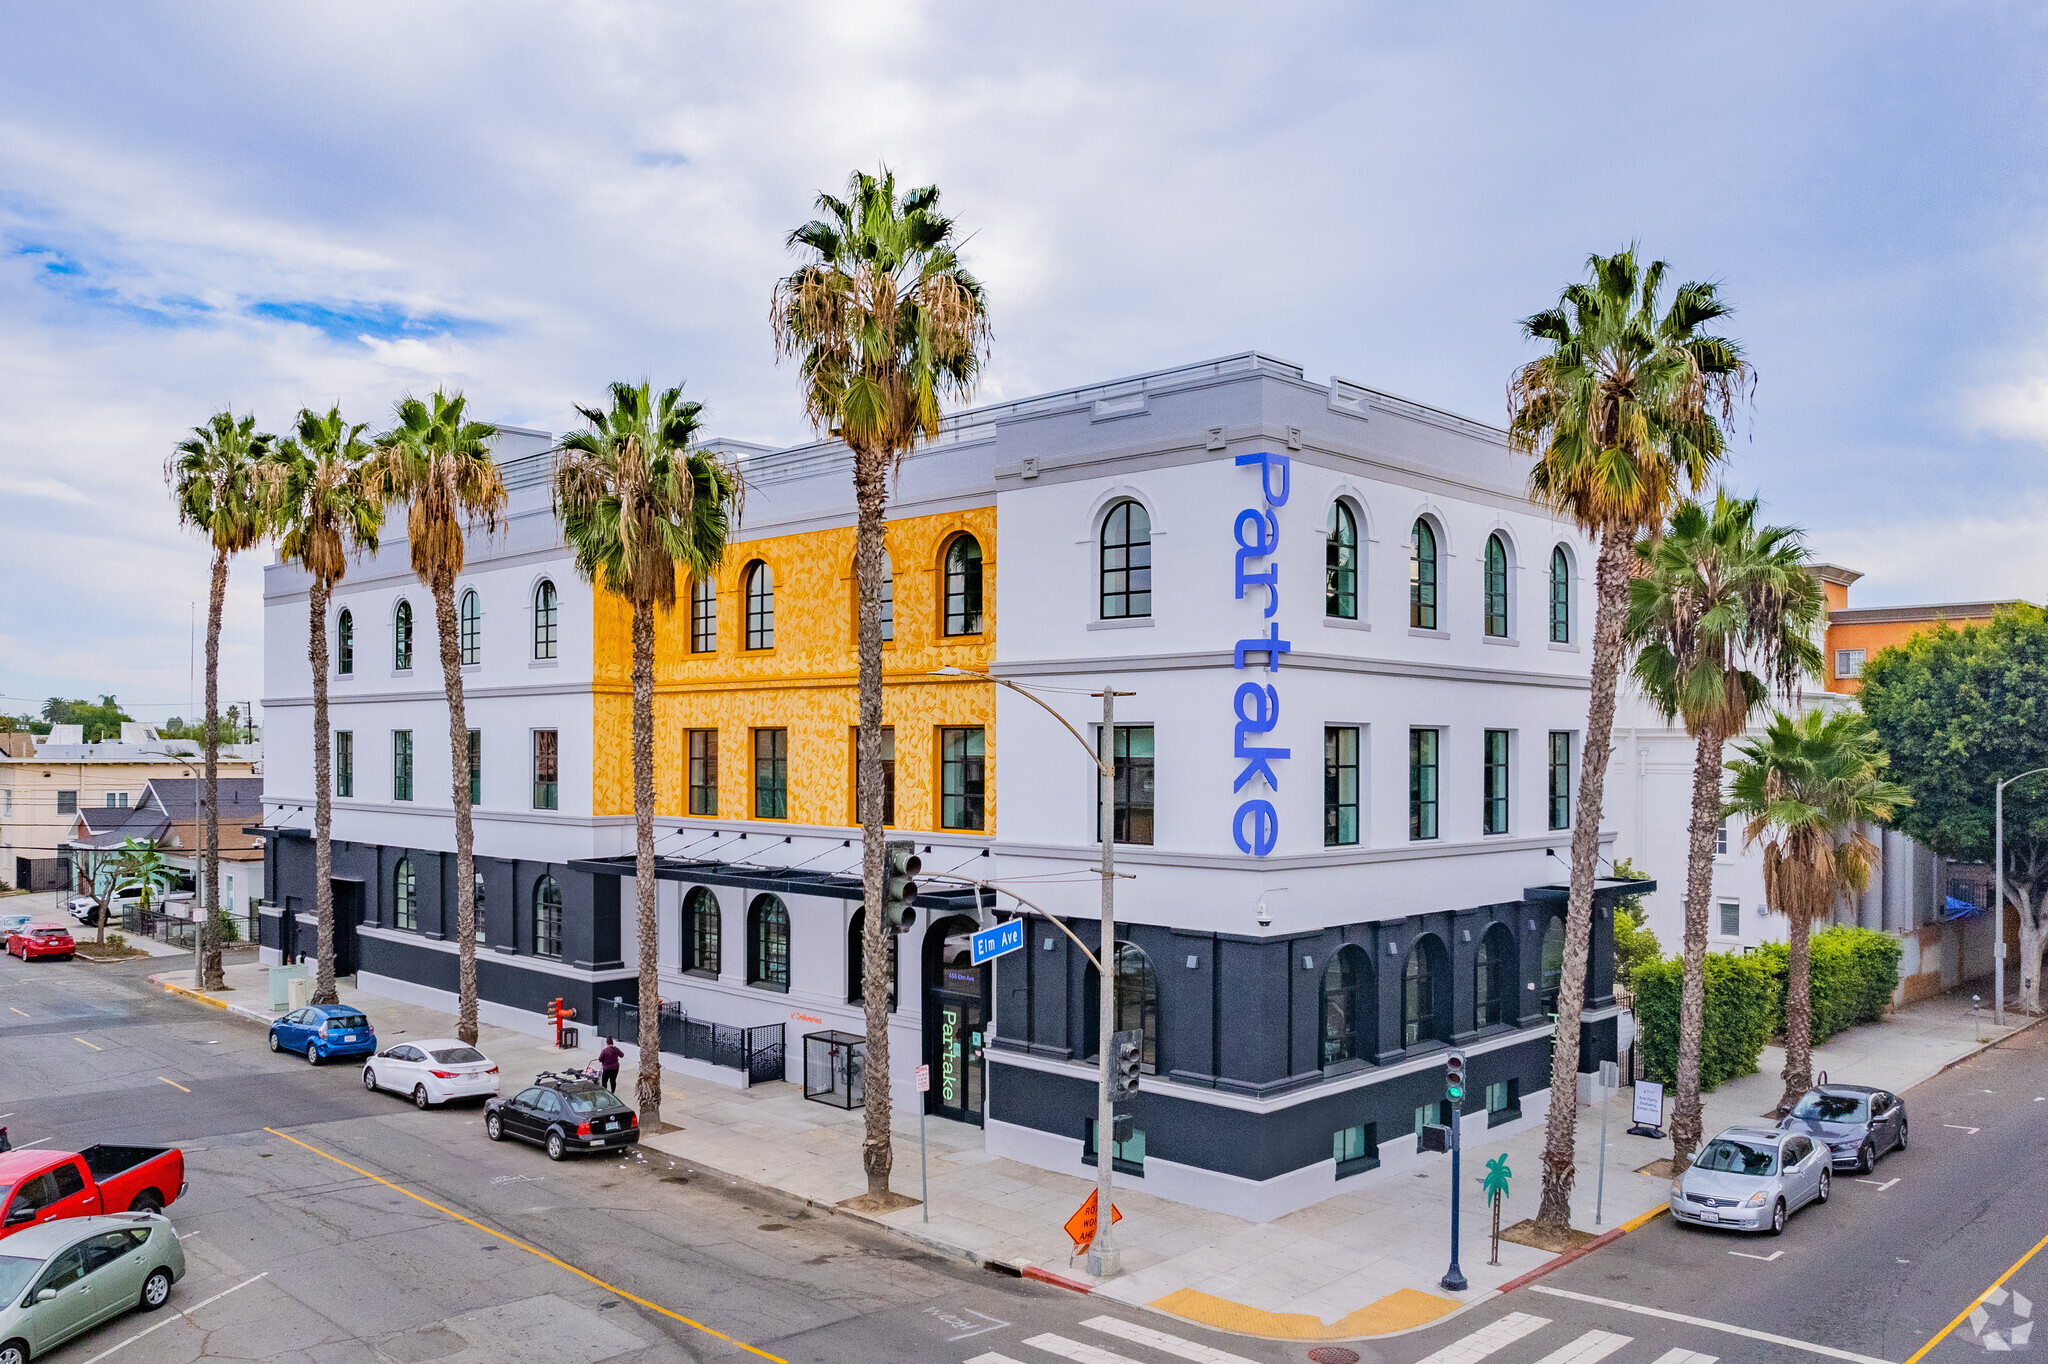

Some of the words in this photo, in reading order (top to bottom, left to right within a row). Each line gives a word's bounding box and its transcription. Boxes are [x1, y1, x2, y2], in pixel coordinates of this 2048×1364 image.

[1232, 452, 1291, 857] Partake
[978, 939, 996, 956] Elm
[1002, 930, 1018, 947] Ave
[796, 1012, 822, 1025] Deliveries
[942, 1010, 957, 1101] Partake
[1085, 1205, 1098, 1215] RO
[1083, 1217, 1098, 1227] WOR
[1079, 1230, 1095, 1240] AHE
